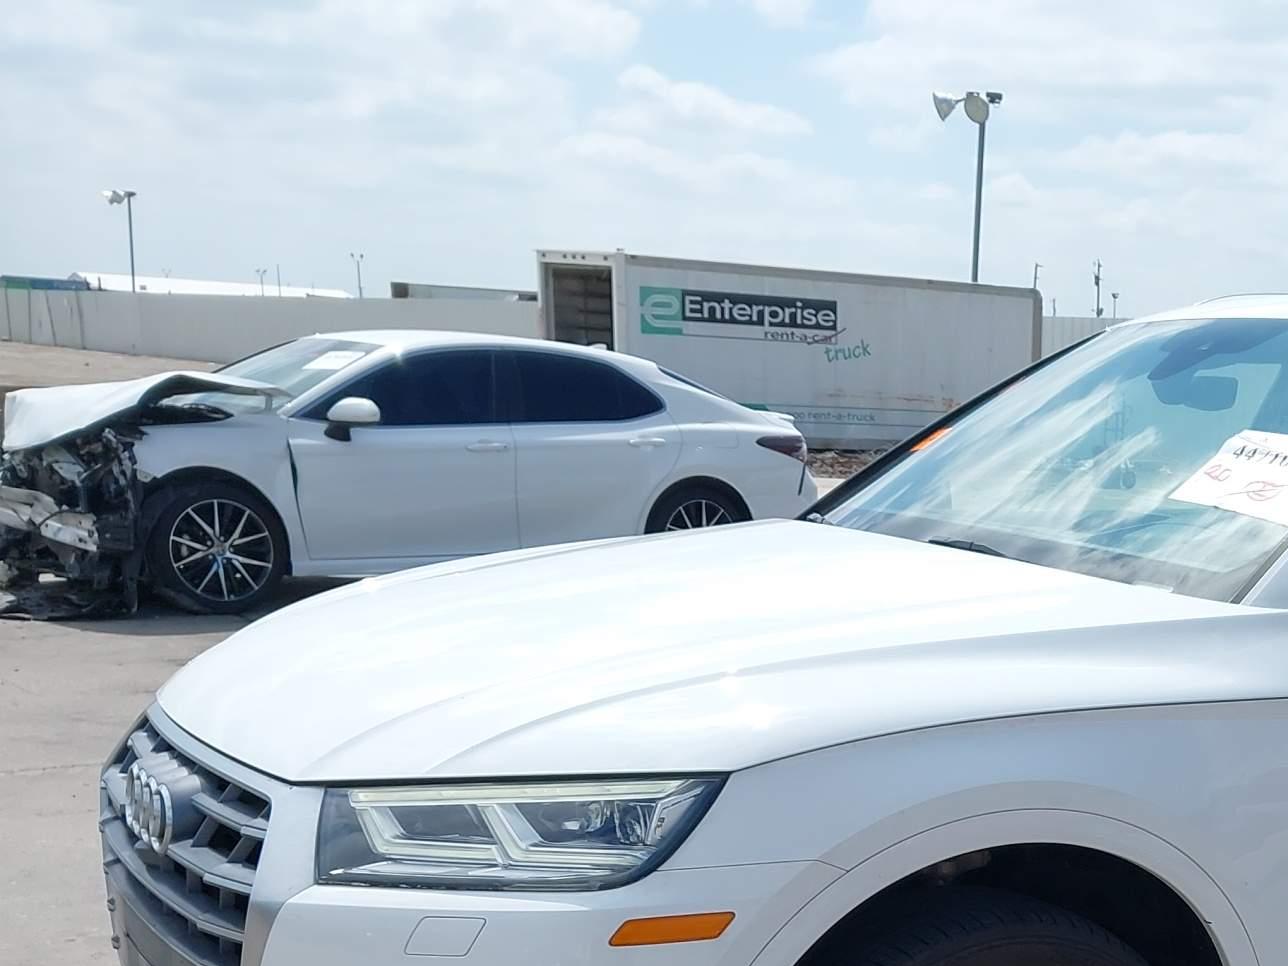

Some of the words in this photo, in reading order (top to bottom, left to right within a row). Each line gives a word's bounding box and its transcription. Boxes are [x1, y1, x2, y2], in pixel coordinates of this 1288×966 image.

[684, 296, 836, 327] Enterprise
[763, 329, 834, 344] rent-a-car
[824, 339, 872, 363] truck
